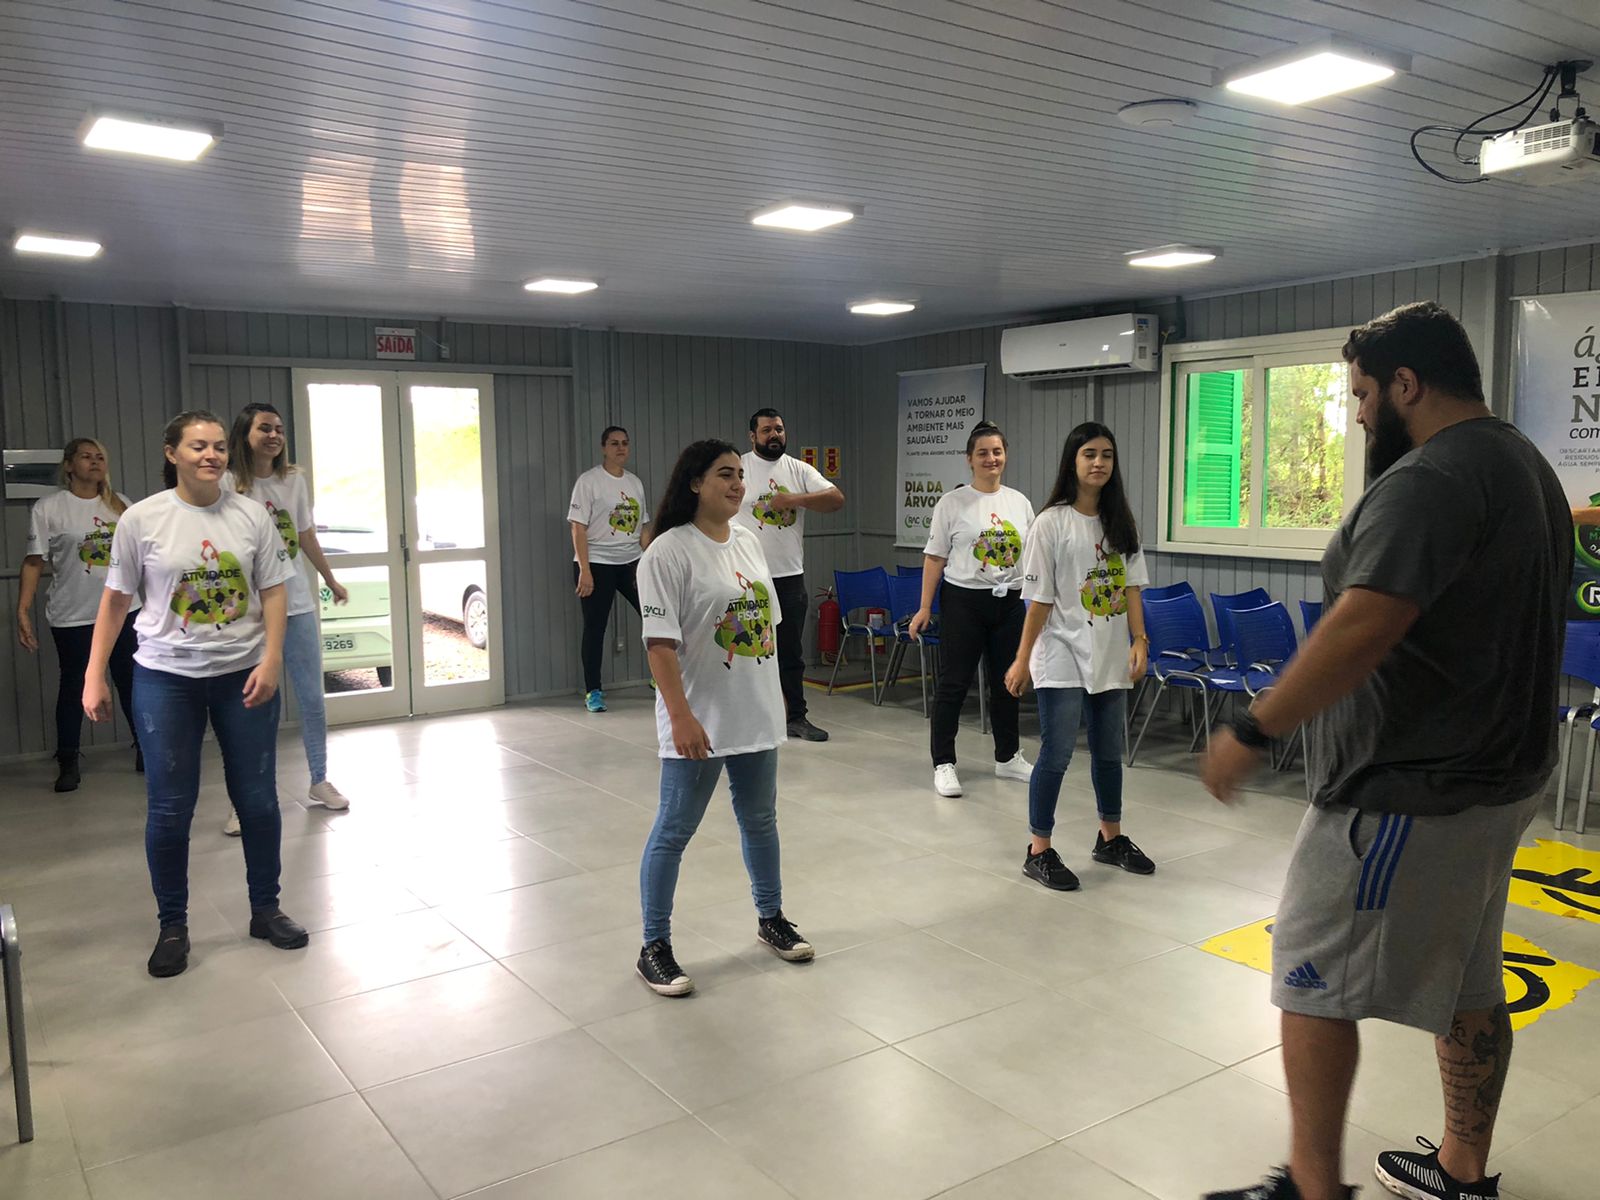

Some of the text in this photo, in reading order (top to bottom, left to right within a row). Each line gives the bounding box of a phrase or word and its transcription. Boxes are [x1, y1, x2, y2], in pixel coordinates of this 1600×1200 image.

[1574, 326, 1600, 364] á
[1572, 367, 1600, 388] E
[907, 395, 966, 407] VAMOS AJUDAR
[907, 408, 975, 420] A TORNAR O MEIO
[907, 421, 964, 432] AMBIENTE MAIS
[907, 434, 948, 445] SAUDÁVEL?
[905, 480, 943, 493] DIA DA
[904, 493, 941, 508] ÁRVO
[181, 569, 241, 582] ATIVIDADE
[727, 599, 769, 612] ATIVIDADE
[1284, 976, 1328, 990] adidas
